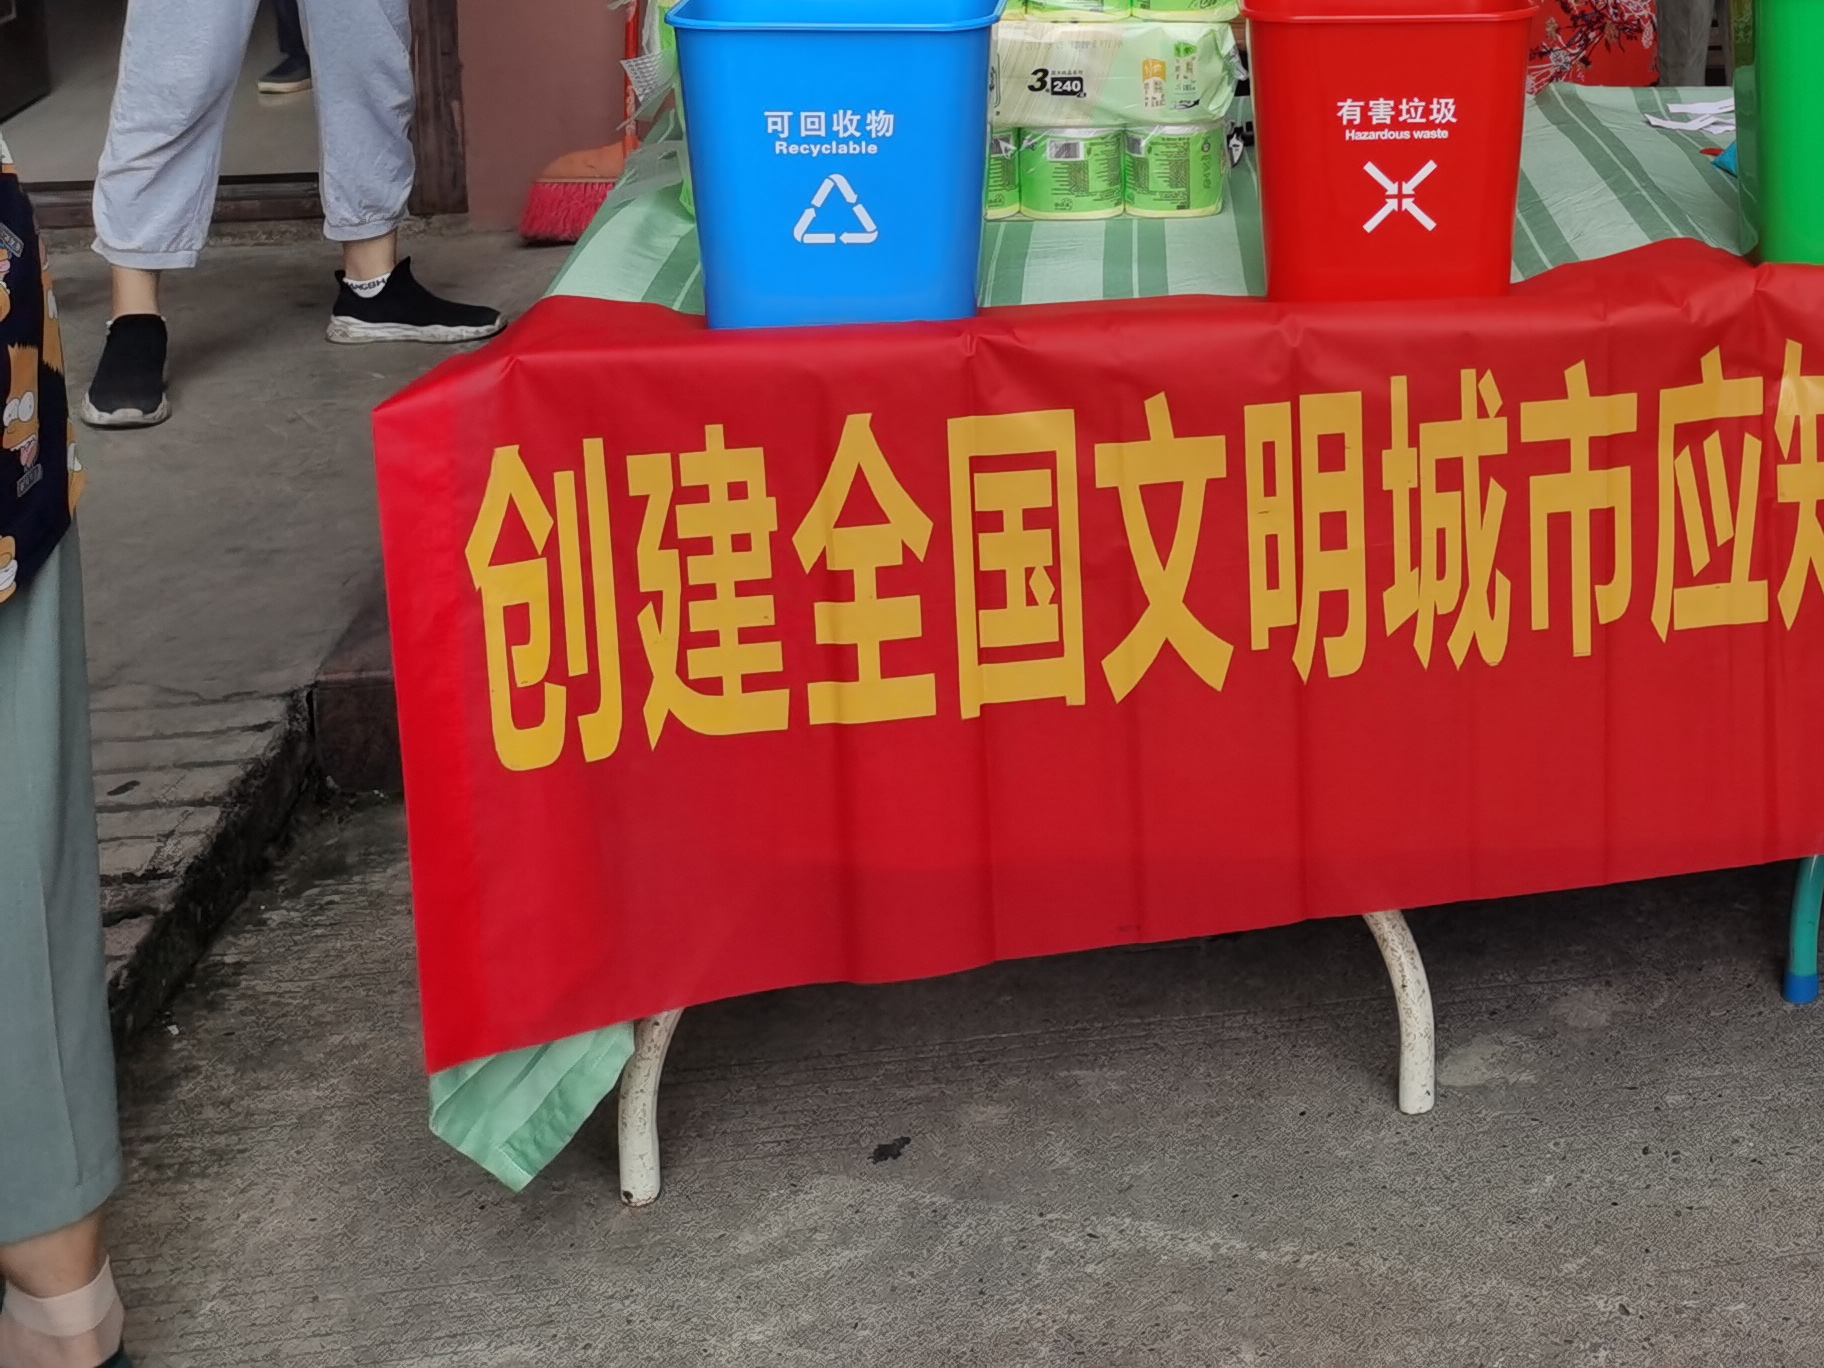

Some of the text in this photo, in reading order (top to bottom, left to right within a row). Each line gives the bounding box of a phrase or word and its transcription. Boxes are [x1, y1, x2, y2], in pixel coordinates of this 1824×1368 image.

[1027, 68, 1082, 93] 3 240
[1336, 96, 1458, 125] 有害垃圾
[763, 109, 895, 139] 可回收物
[1345, 128, 1449, 141] Hazardous waste
[774, 140, 878, 158] Recyclable
